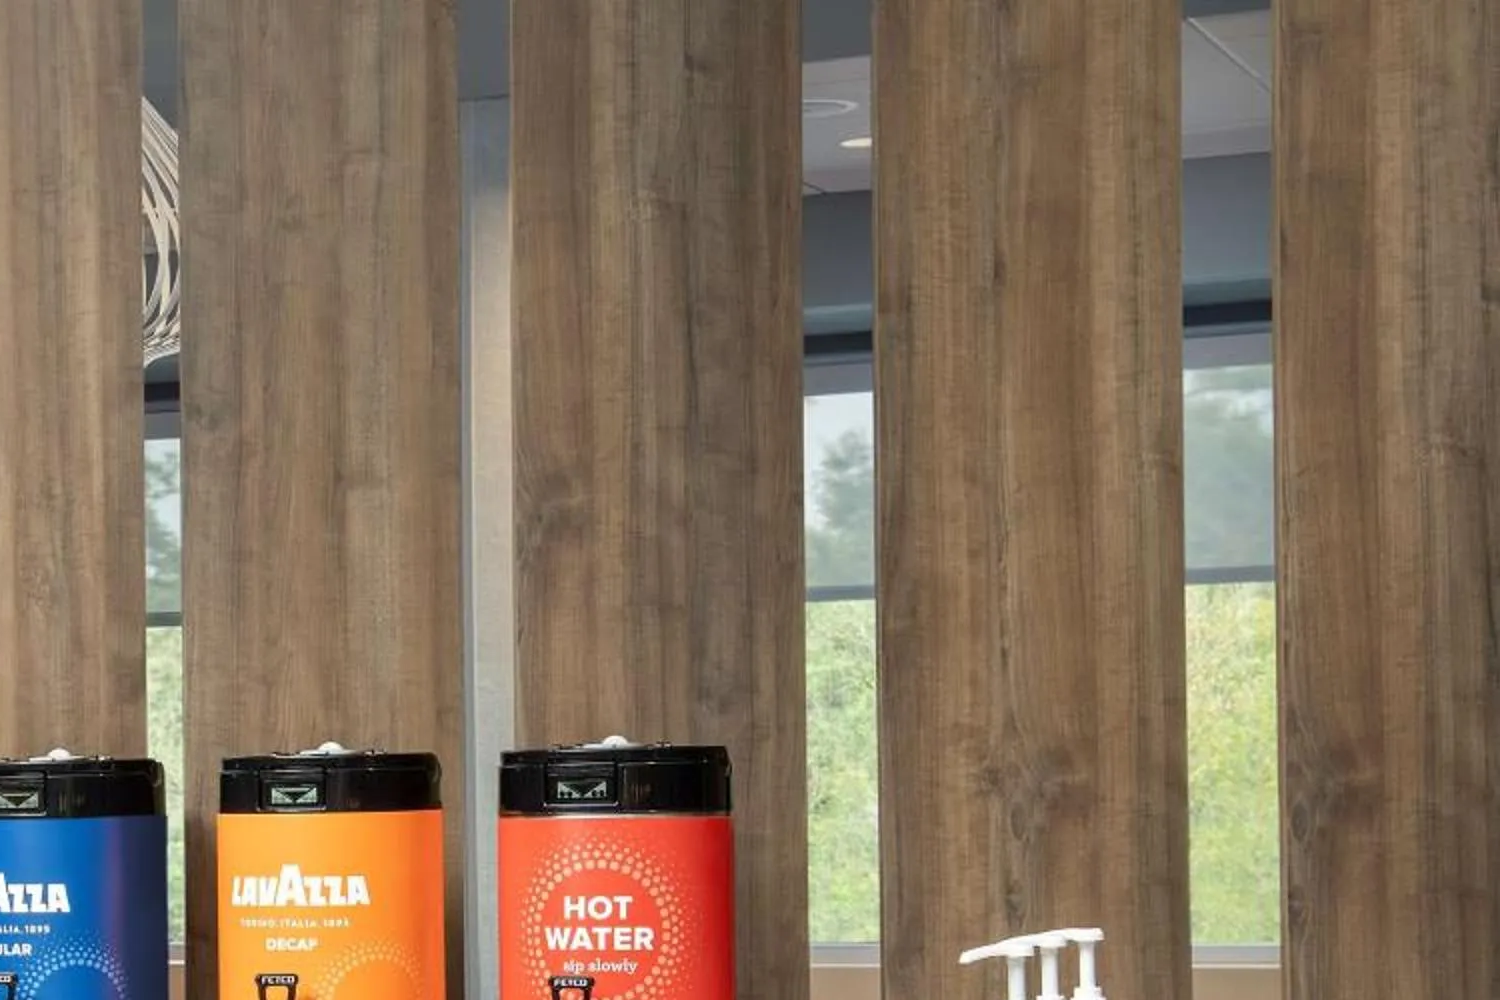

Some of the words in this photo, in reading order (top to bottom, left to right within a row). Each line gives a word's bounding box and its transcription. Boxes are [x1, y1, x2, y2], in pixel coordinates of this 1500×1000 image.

[231, 863, 371, 907] LAVAZZA
[563, 895, 633, 920] HOT
[544, 926, 655, 951] WATER
[563, 960, 585, 974] sip
[587, 957, 638, 975] slowly
[260, 975, 296, 985] FETCO
